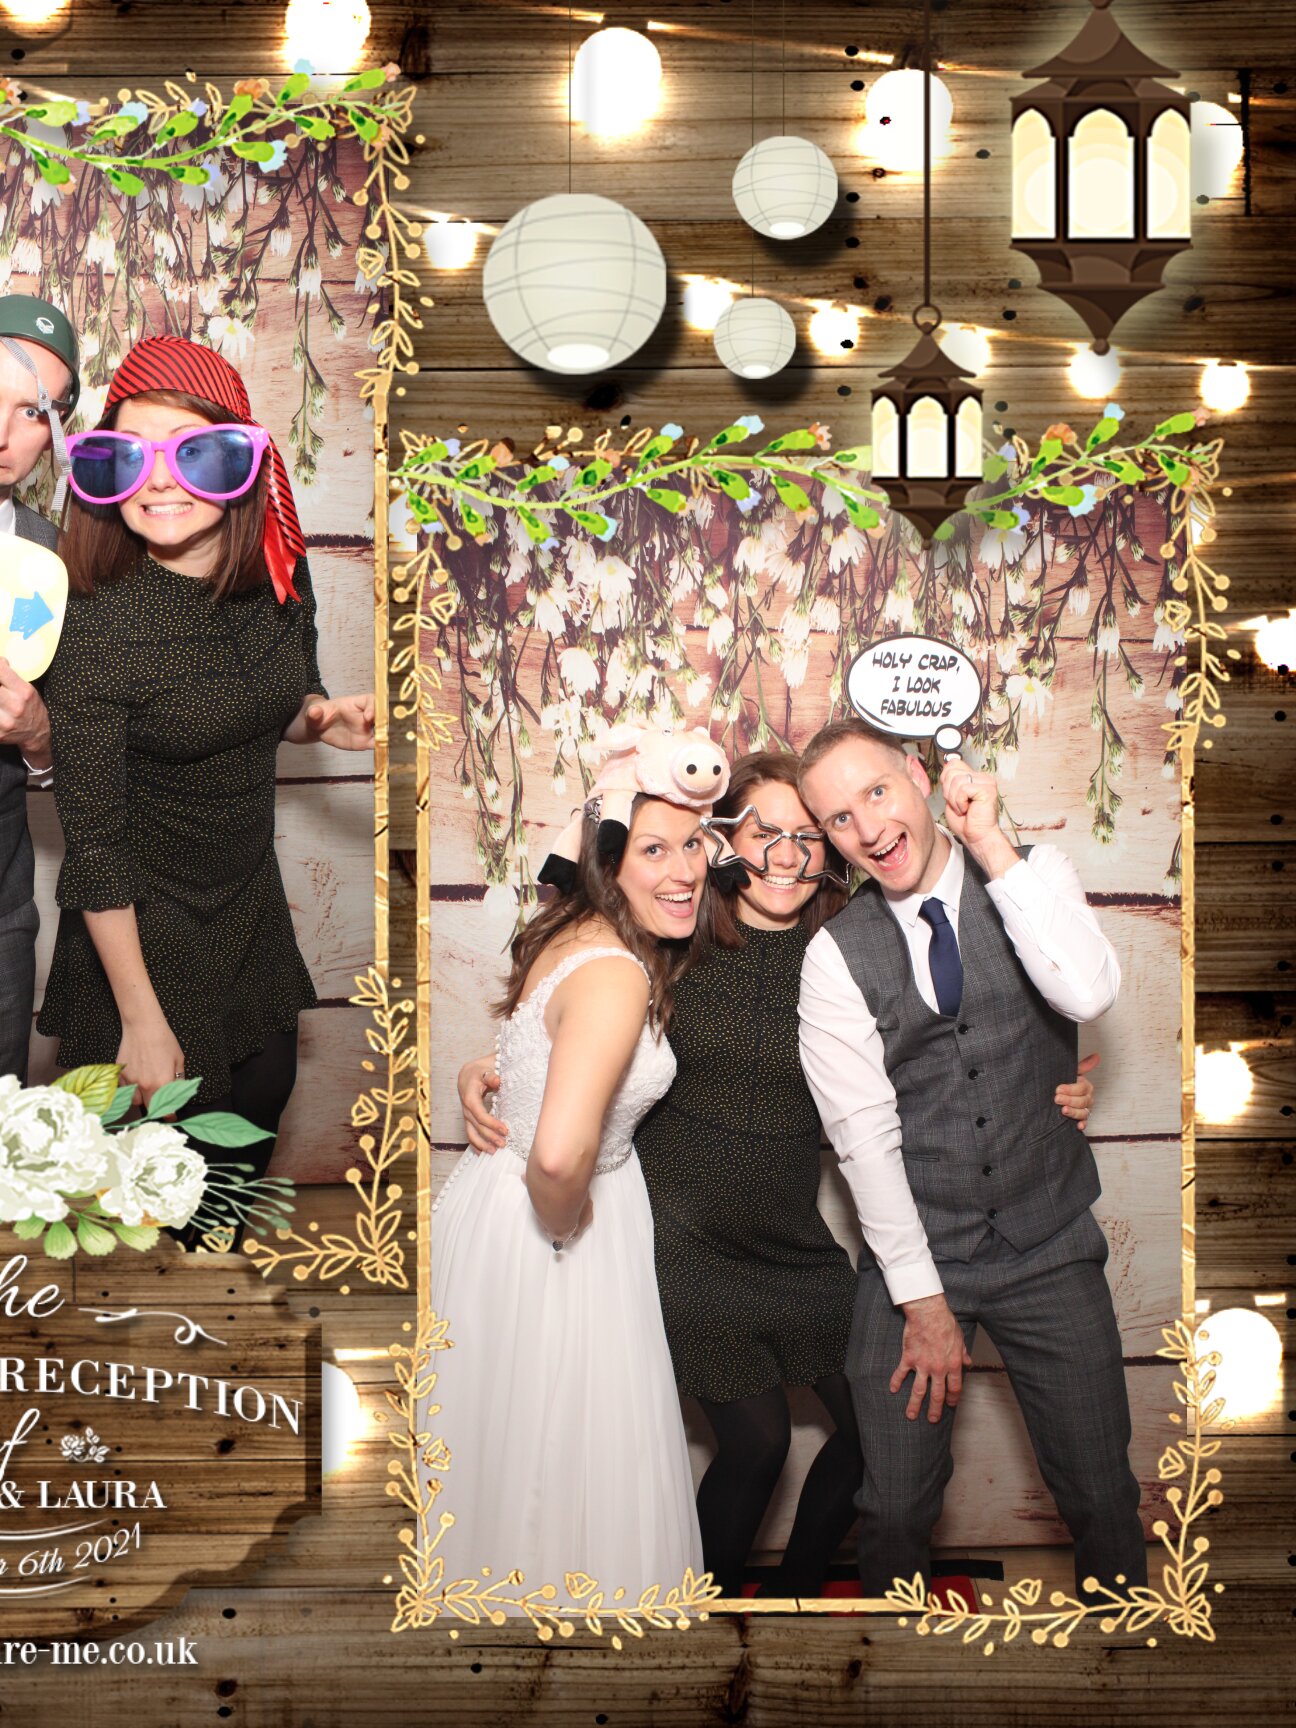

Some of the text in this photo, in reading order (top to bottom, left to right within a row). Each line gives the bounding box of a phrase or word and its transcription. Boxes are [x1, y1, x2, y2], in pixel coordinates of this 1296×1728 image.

[872, 651, 961, 675] HOLY CRAP,
[892, 675, 941, 694] I LOOK
[880, 698, 953, 718] FABULOUS
